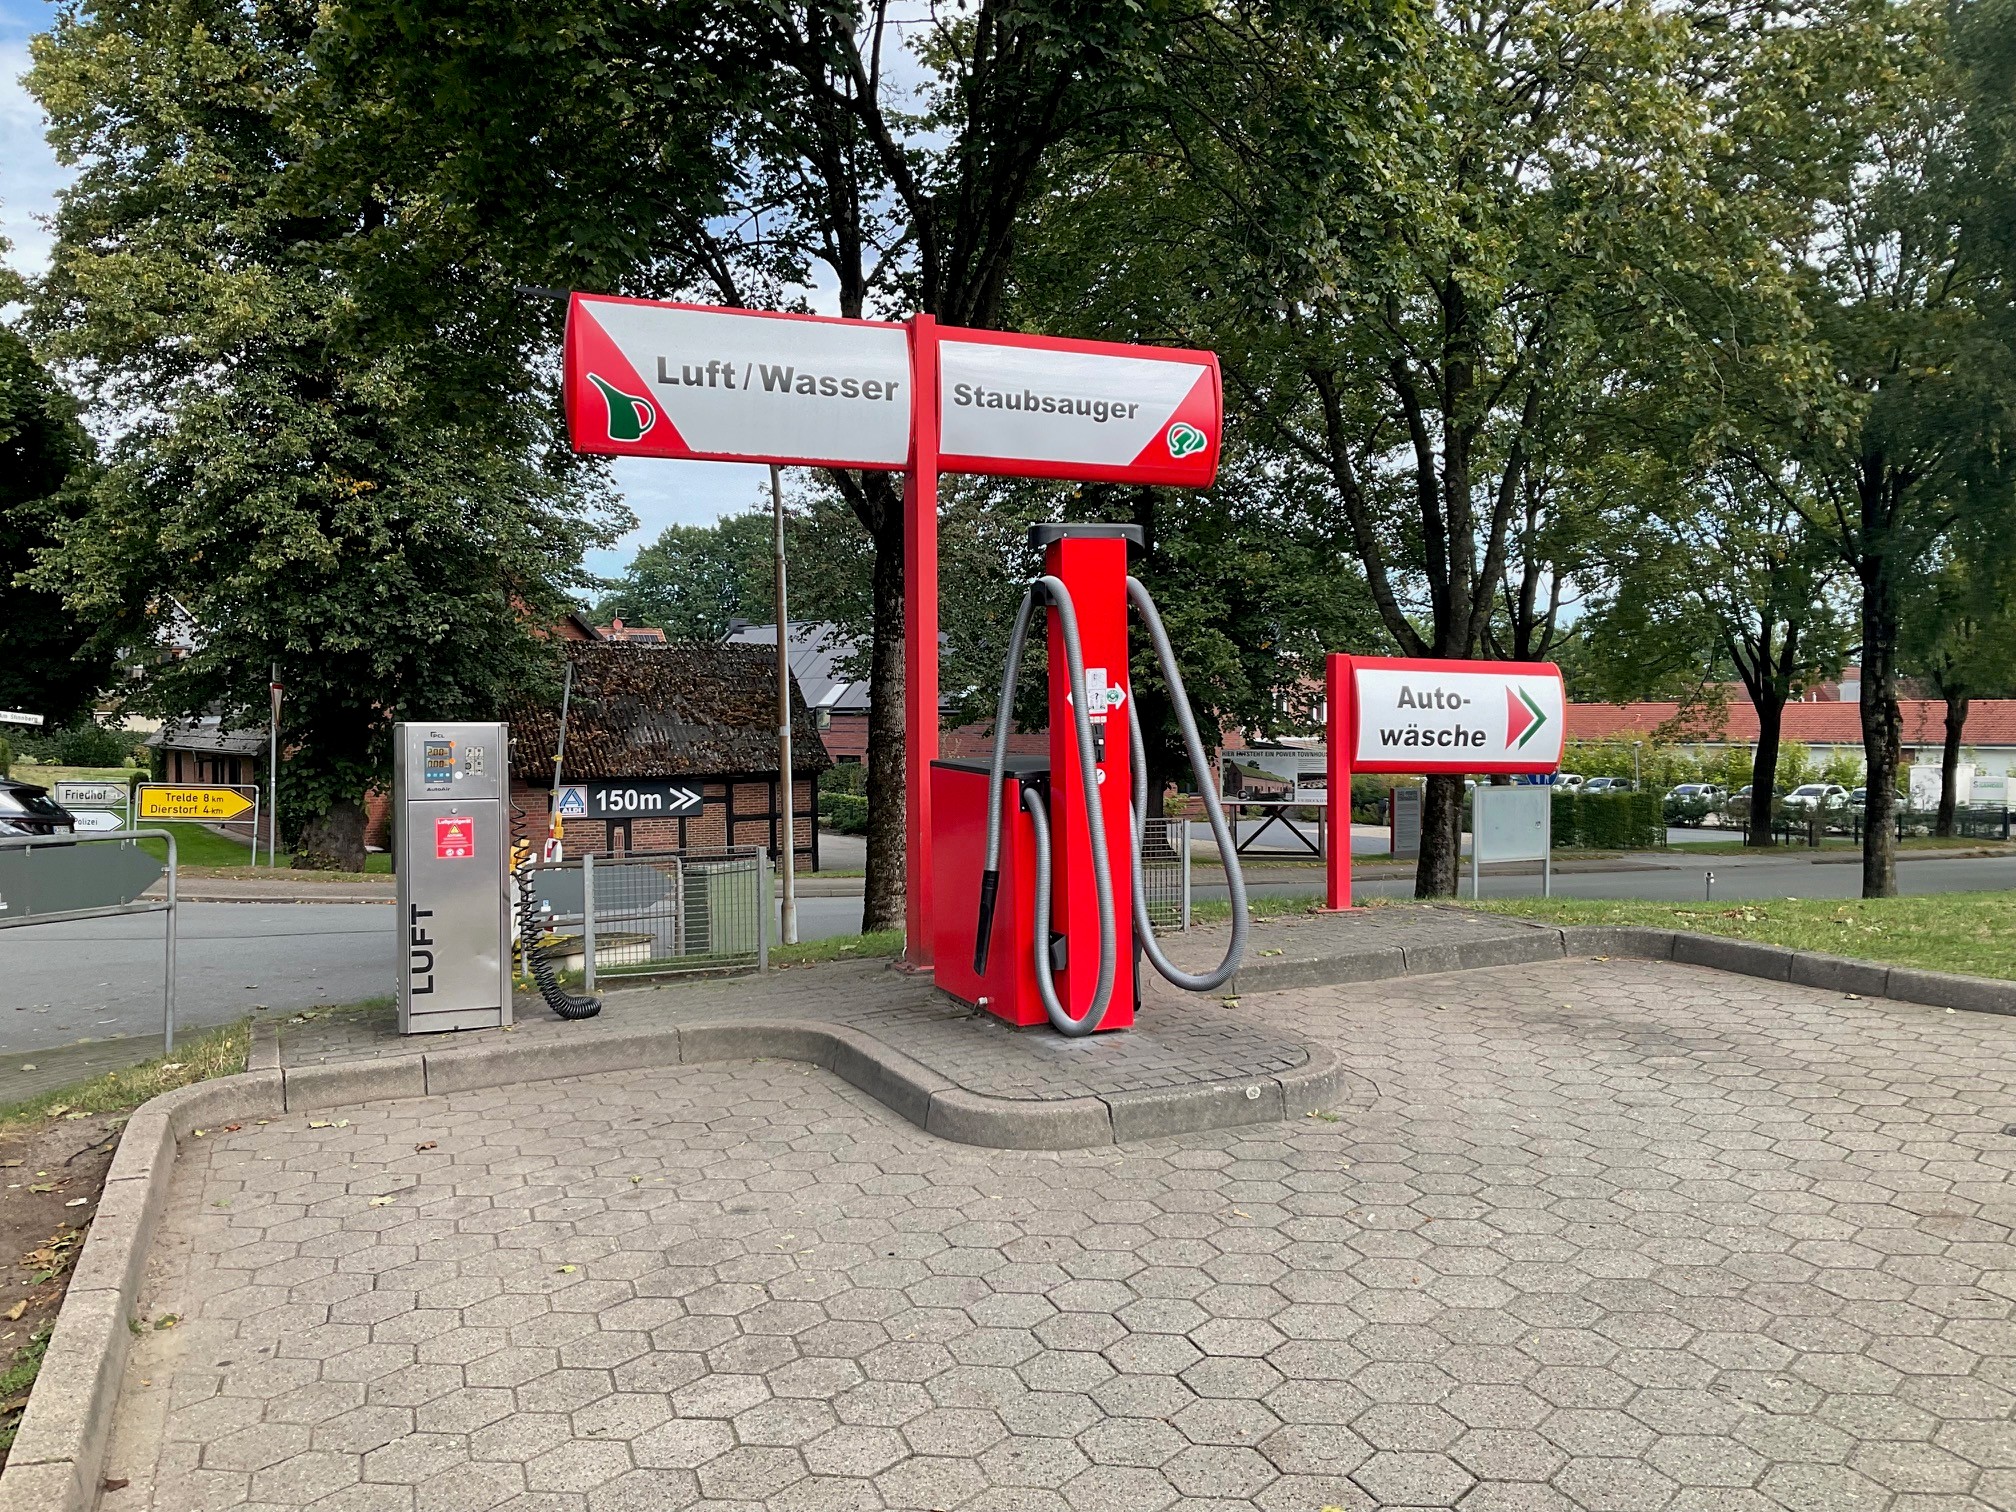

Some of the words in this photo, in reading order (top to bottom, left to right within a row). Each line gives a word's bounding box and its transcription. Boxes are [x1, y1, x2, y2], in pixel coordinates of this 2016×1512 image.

[953, 383, 1139, 422] Staubsauger
[1397, 685, 1471, 710] Auto-
[1380, 723, 1487, 747] wäsche
[65, 789, 107, 800] Friedhof
[165, 792, 198, 803] Trelde
[203, 793, 210, 803] 8
[596, 789, 662, 811] 150m
[150, 804, 198, 814] Dierstorf
[202, 805, 209, 814] 4
[74, 817, 98, 825] Polizei
[411, 903, 434, 995] LUFT
